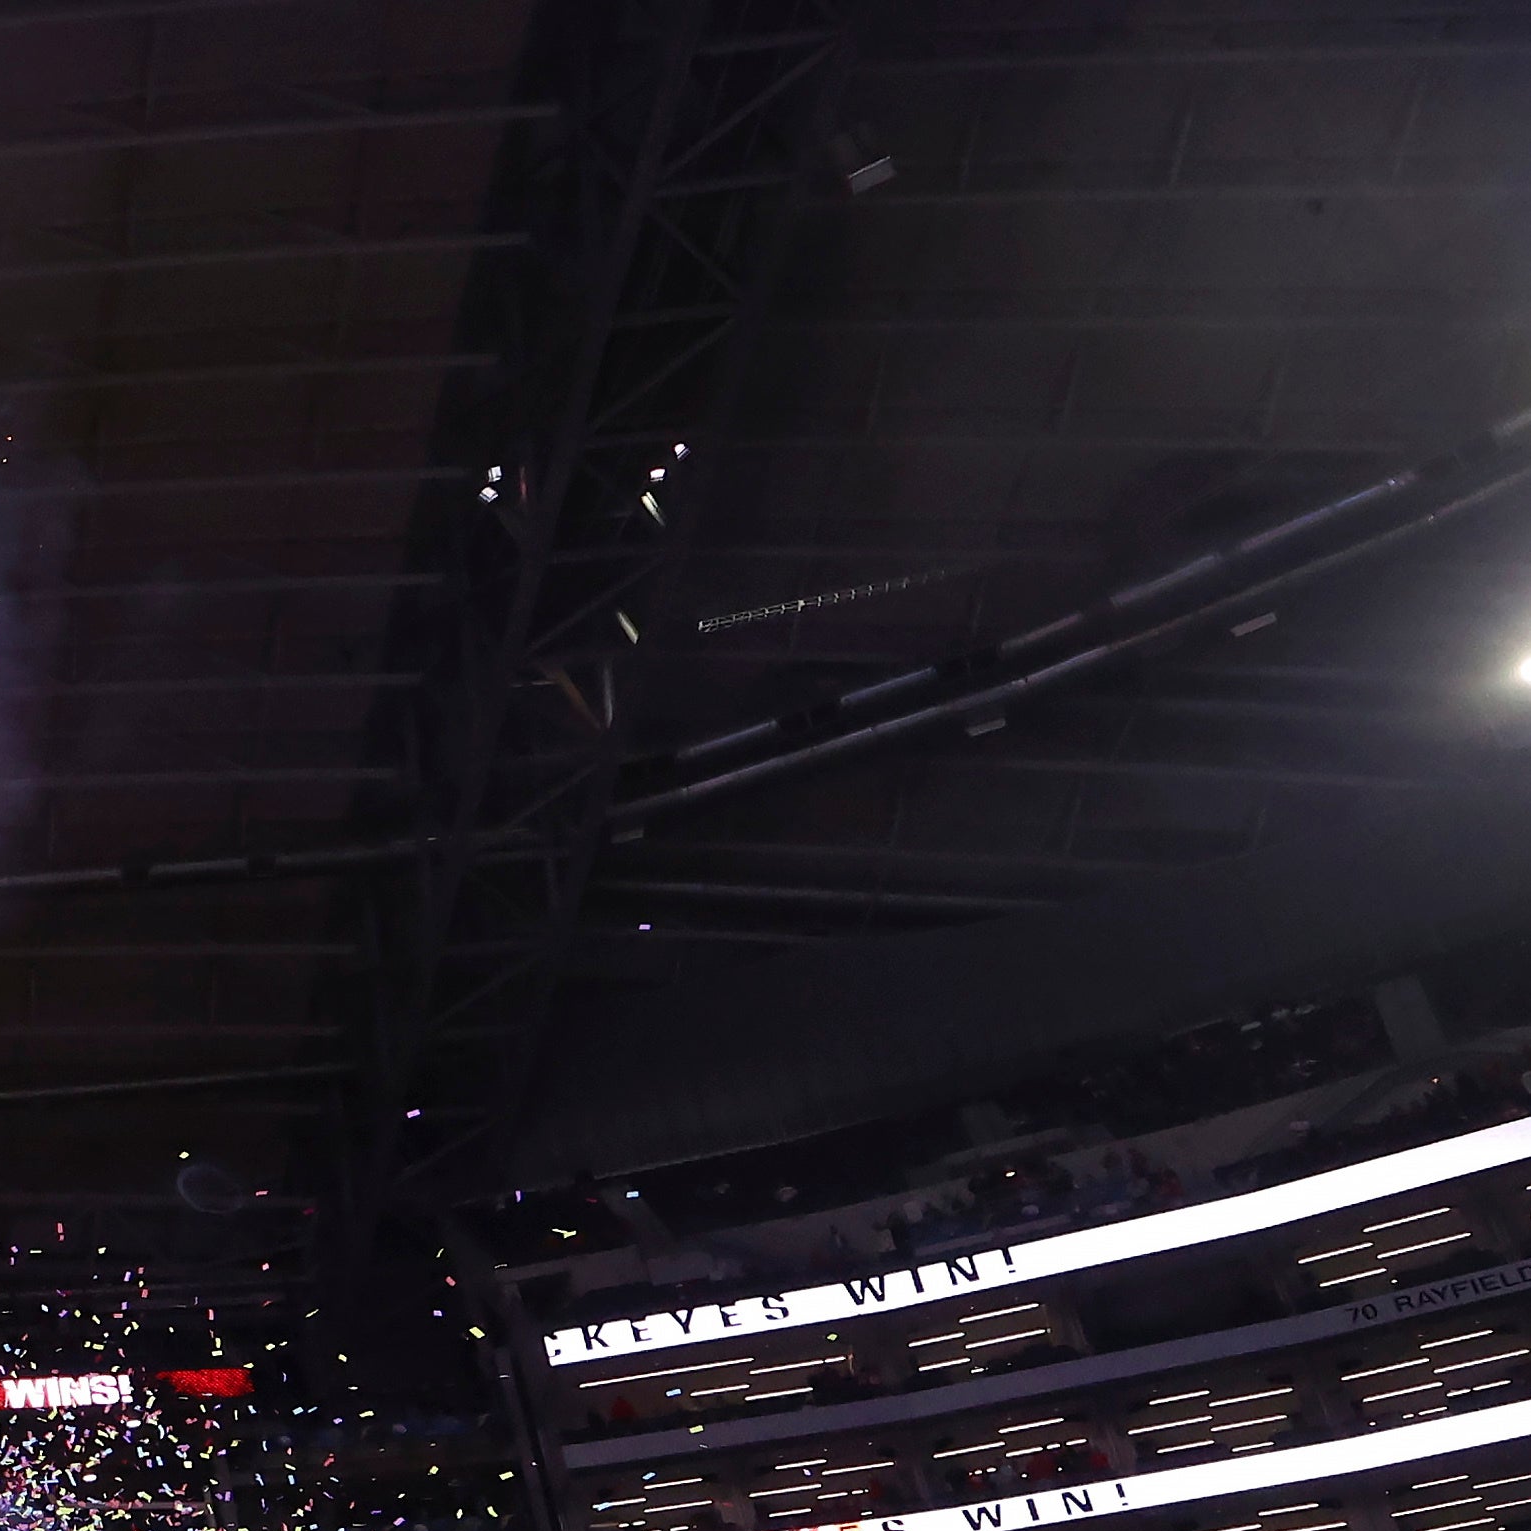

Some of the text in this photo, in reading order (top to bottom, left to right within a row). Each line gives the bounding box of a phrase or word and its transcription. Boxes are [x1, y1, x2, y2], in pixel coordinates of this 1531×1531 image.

[842, 1249, 1019, 1306] WIN!
[1345, 1303, 1379, 1323] 70
[4, 1373, 132, 1408] WINS!
[962, 1483, 1130, 1531] WIN!
